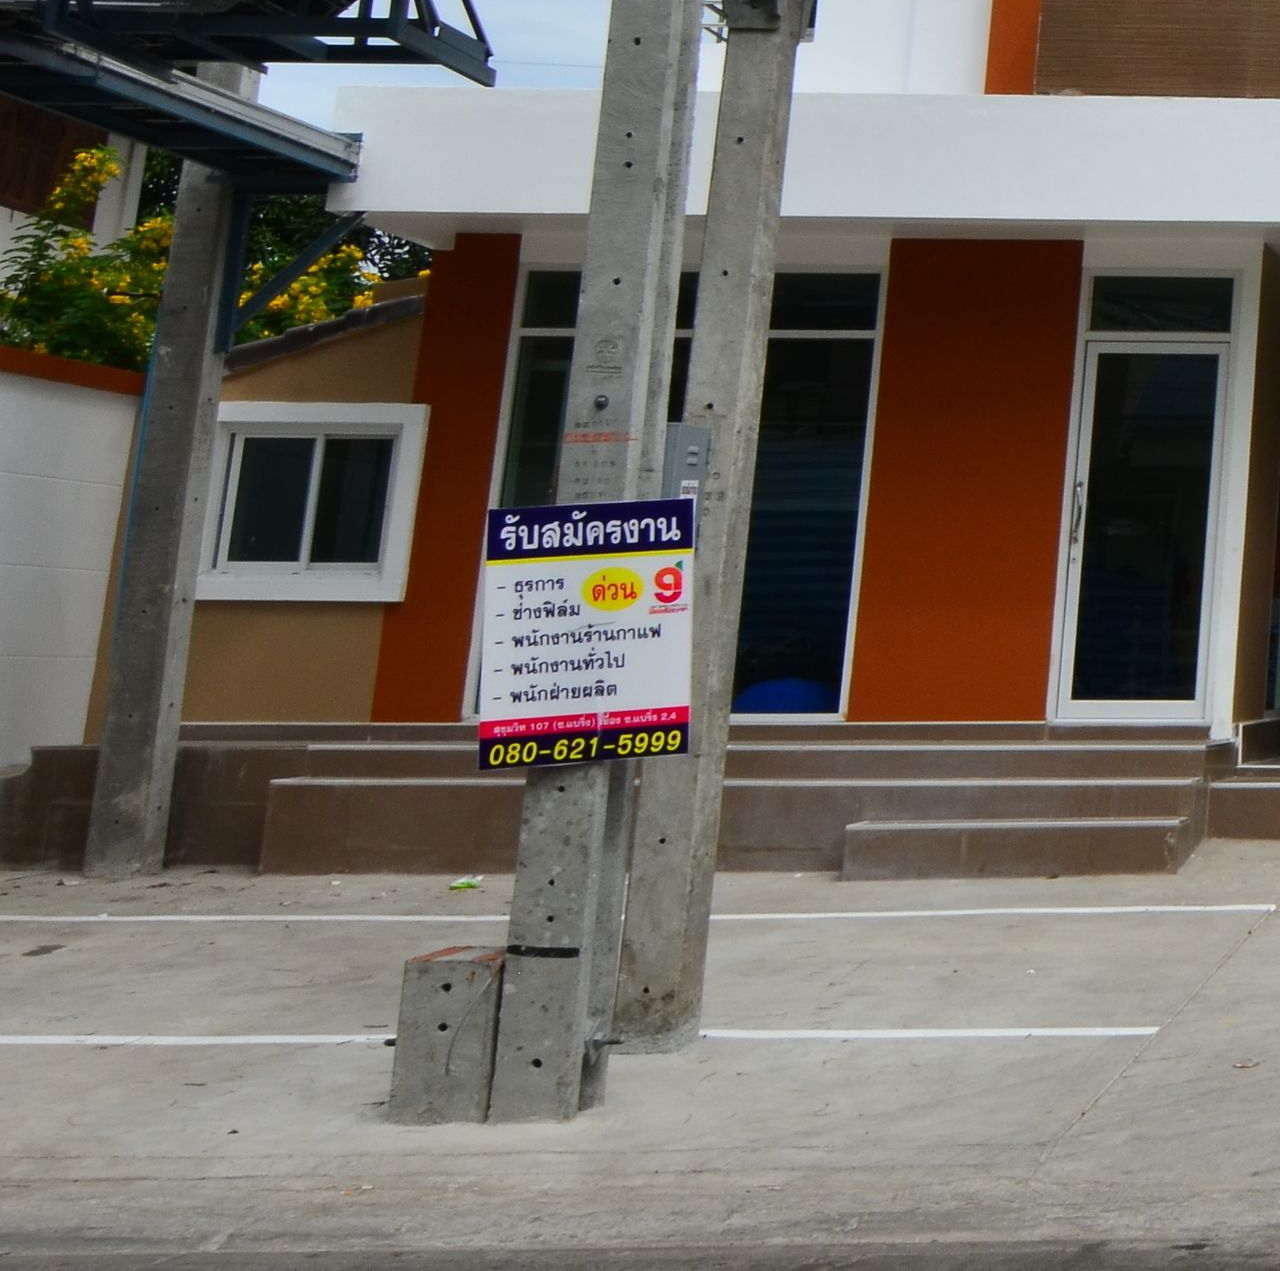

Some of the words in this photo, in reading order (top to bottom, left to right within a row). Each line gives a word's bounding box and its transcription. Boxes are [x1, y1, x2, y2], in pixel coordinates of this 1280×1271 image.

[499, 512, 682, 551] รับสมัครงาน
[513, 577, 565, 600] ธุรการ
[591, 575, 637, 601] ด่วน
[512, 599, 581, 621] ช่างฟิล์ม
[511, 623, 662, 648] พนักงานร้านกาแฟ
[510, 647, 625, 676] พนักงานทั่วไป
[509, 679, 618, 704] พนักฝ่ายผลิต
[530, 721, 549, 730] 107
[489, 730, 682, 766] 080-621-5999
